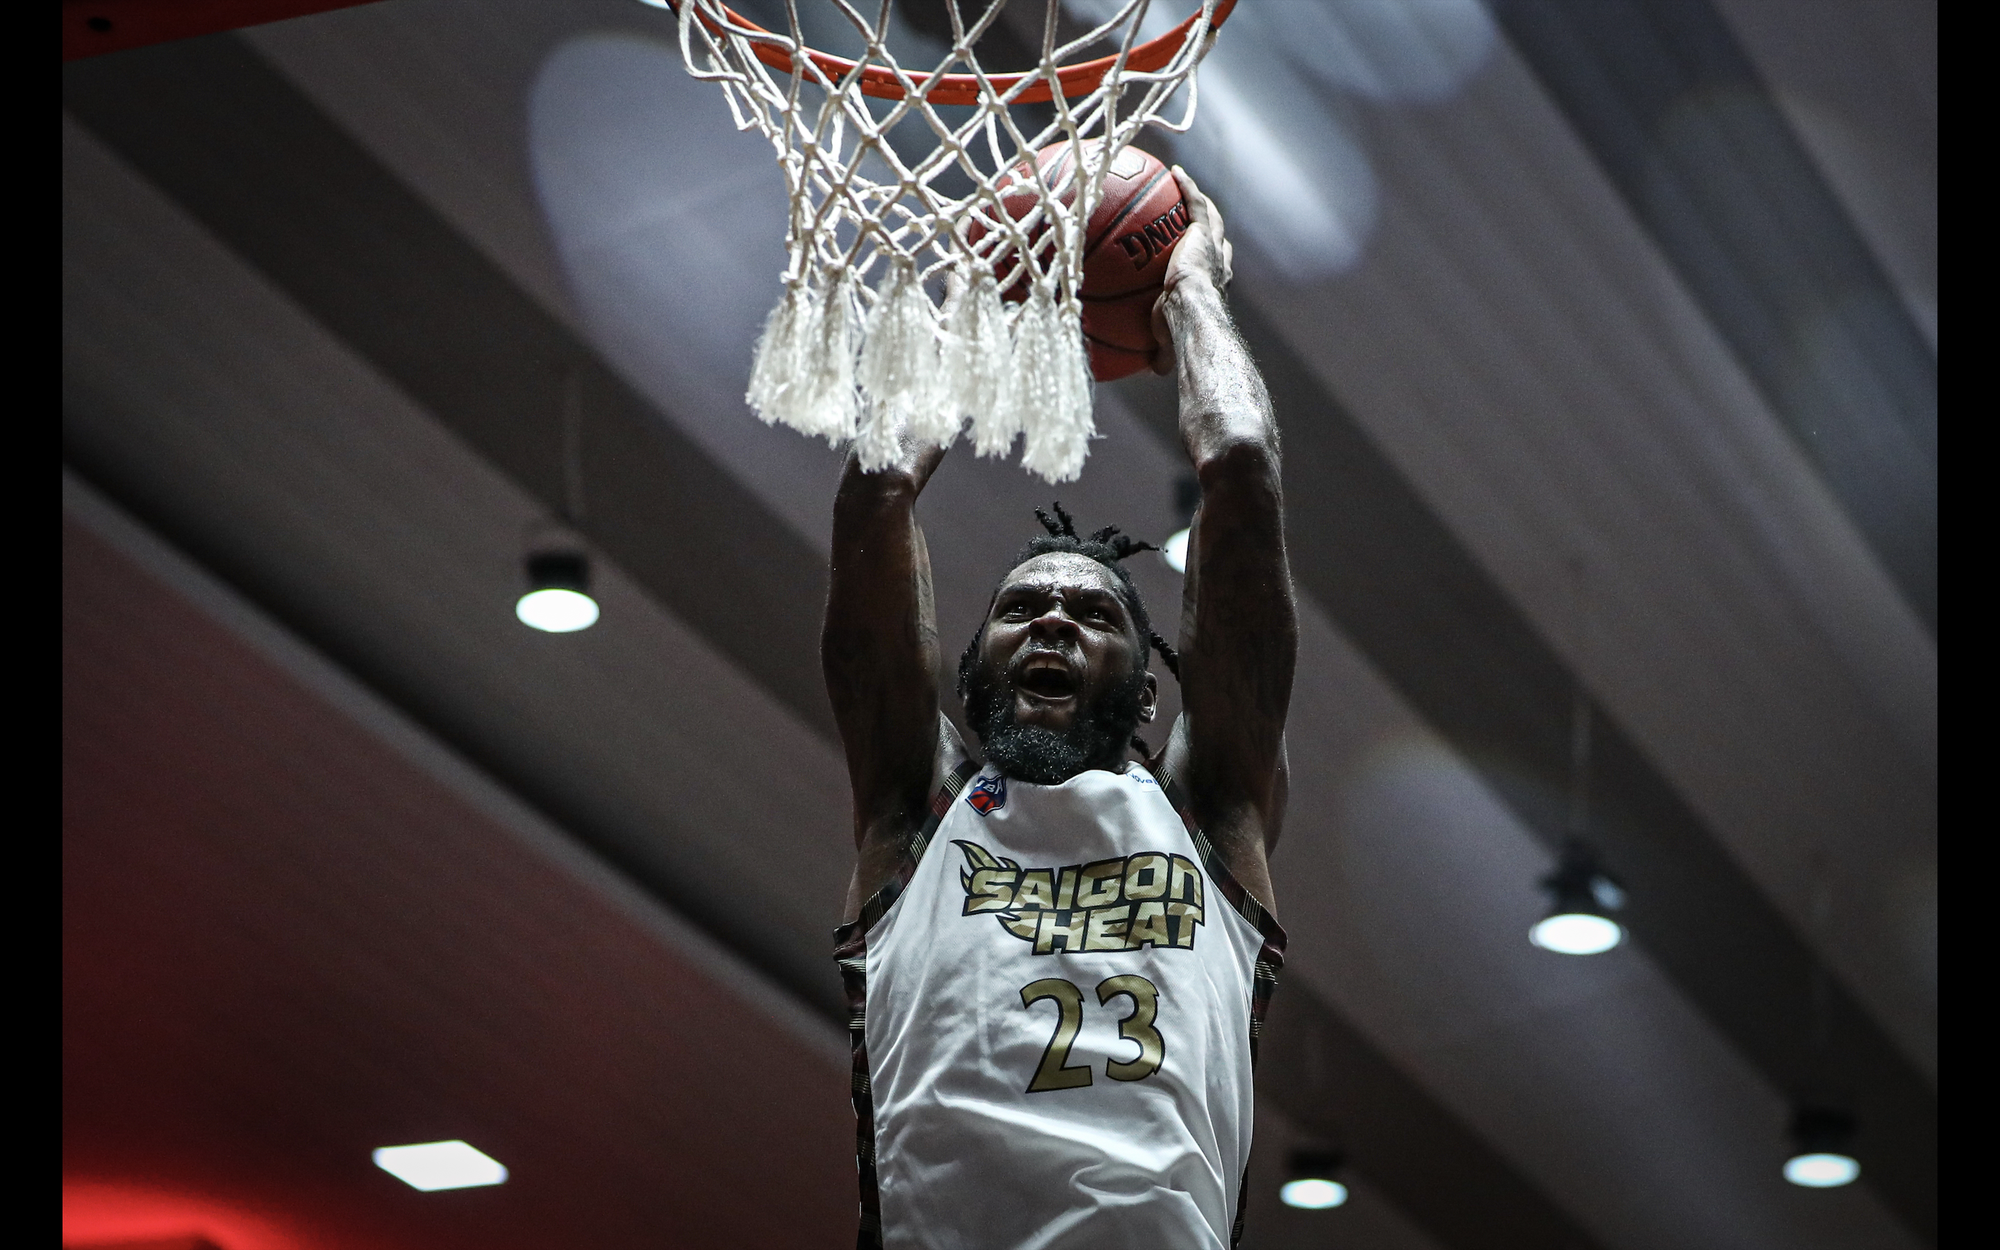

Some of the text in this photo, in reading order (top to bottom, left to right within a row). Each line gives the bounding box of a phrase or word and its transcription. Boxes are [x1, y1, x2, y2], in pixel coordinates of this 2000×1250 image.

[960, 850, 1206, 917] SAIGON
[1000, 902, 1205, 956] HEAT
[1019, 974, 1166, 1093] 23
